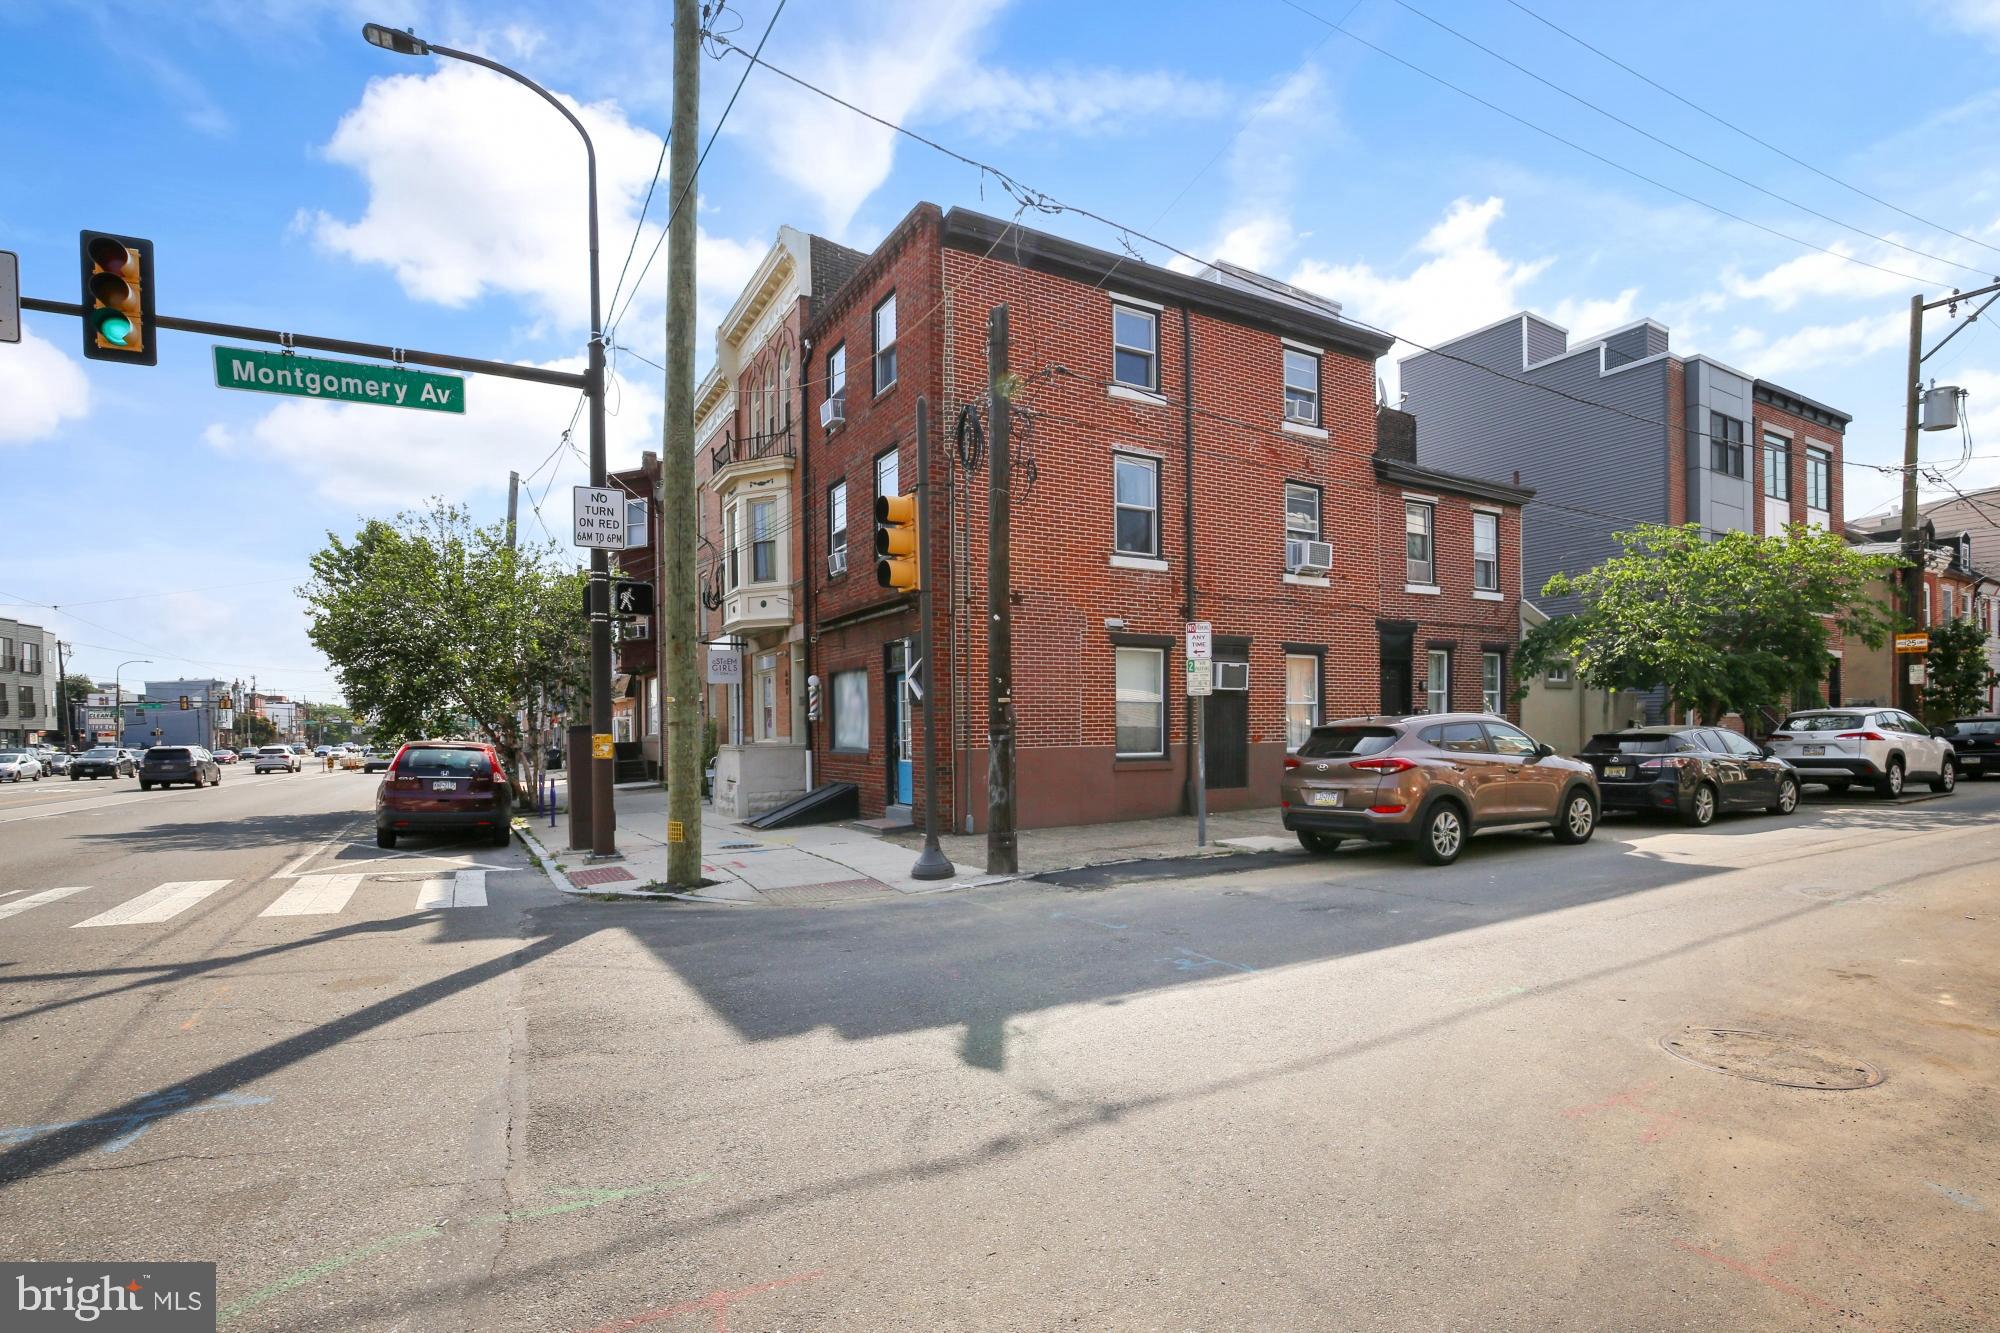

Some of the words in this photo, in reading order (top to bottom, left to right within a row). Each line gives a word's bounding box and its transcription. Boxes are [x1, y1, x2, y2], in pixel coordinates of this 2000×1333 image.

[232, 359, 407, 404] Montgomery
[420, 382, 450, 404] Av
[591, 493, 608, 503] NO
[585, 505, 614, 516] TURN
[579, 517, 594, 528] ON
[598, 519, 620, 529] RED
[577, 532, 593, 541] 6AM
[595, 532, 605, 542] TO
[606, 533, 622, 543] 6PM
[1188, 661, 1194, 671] 2
